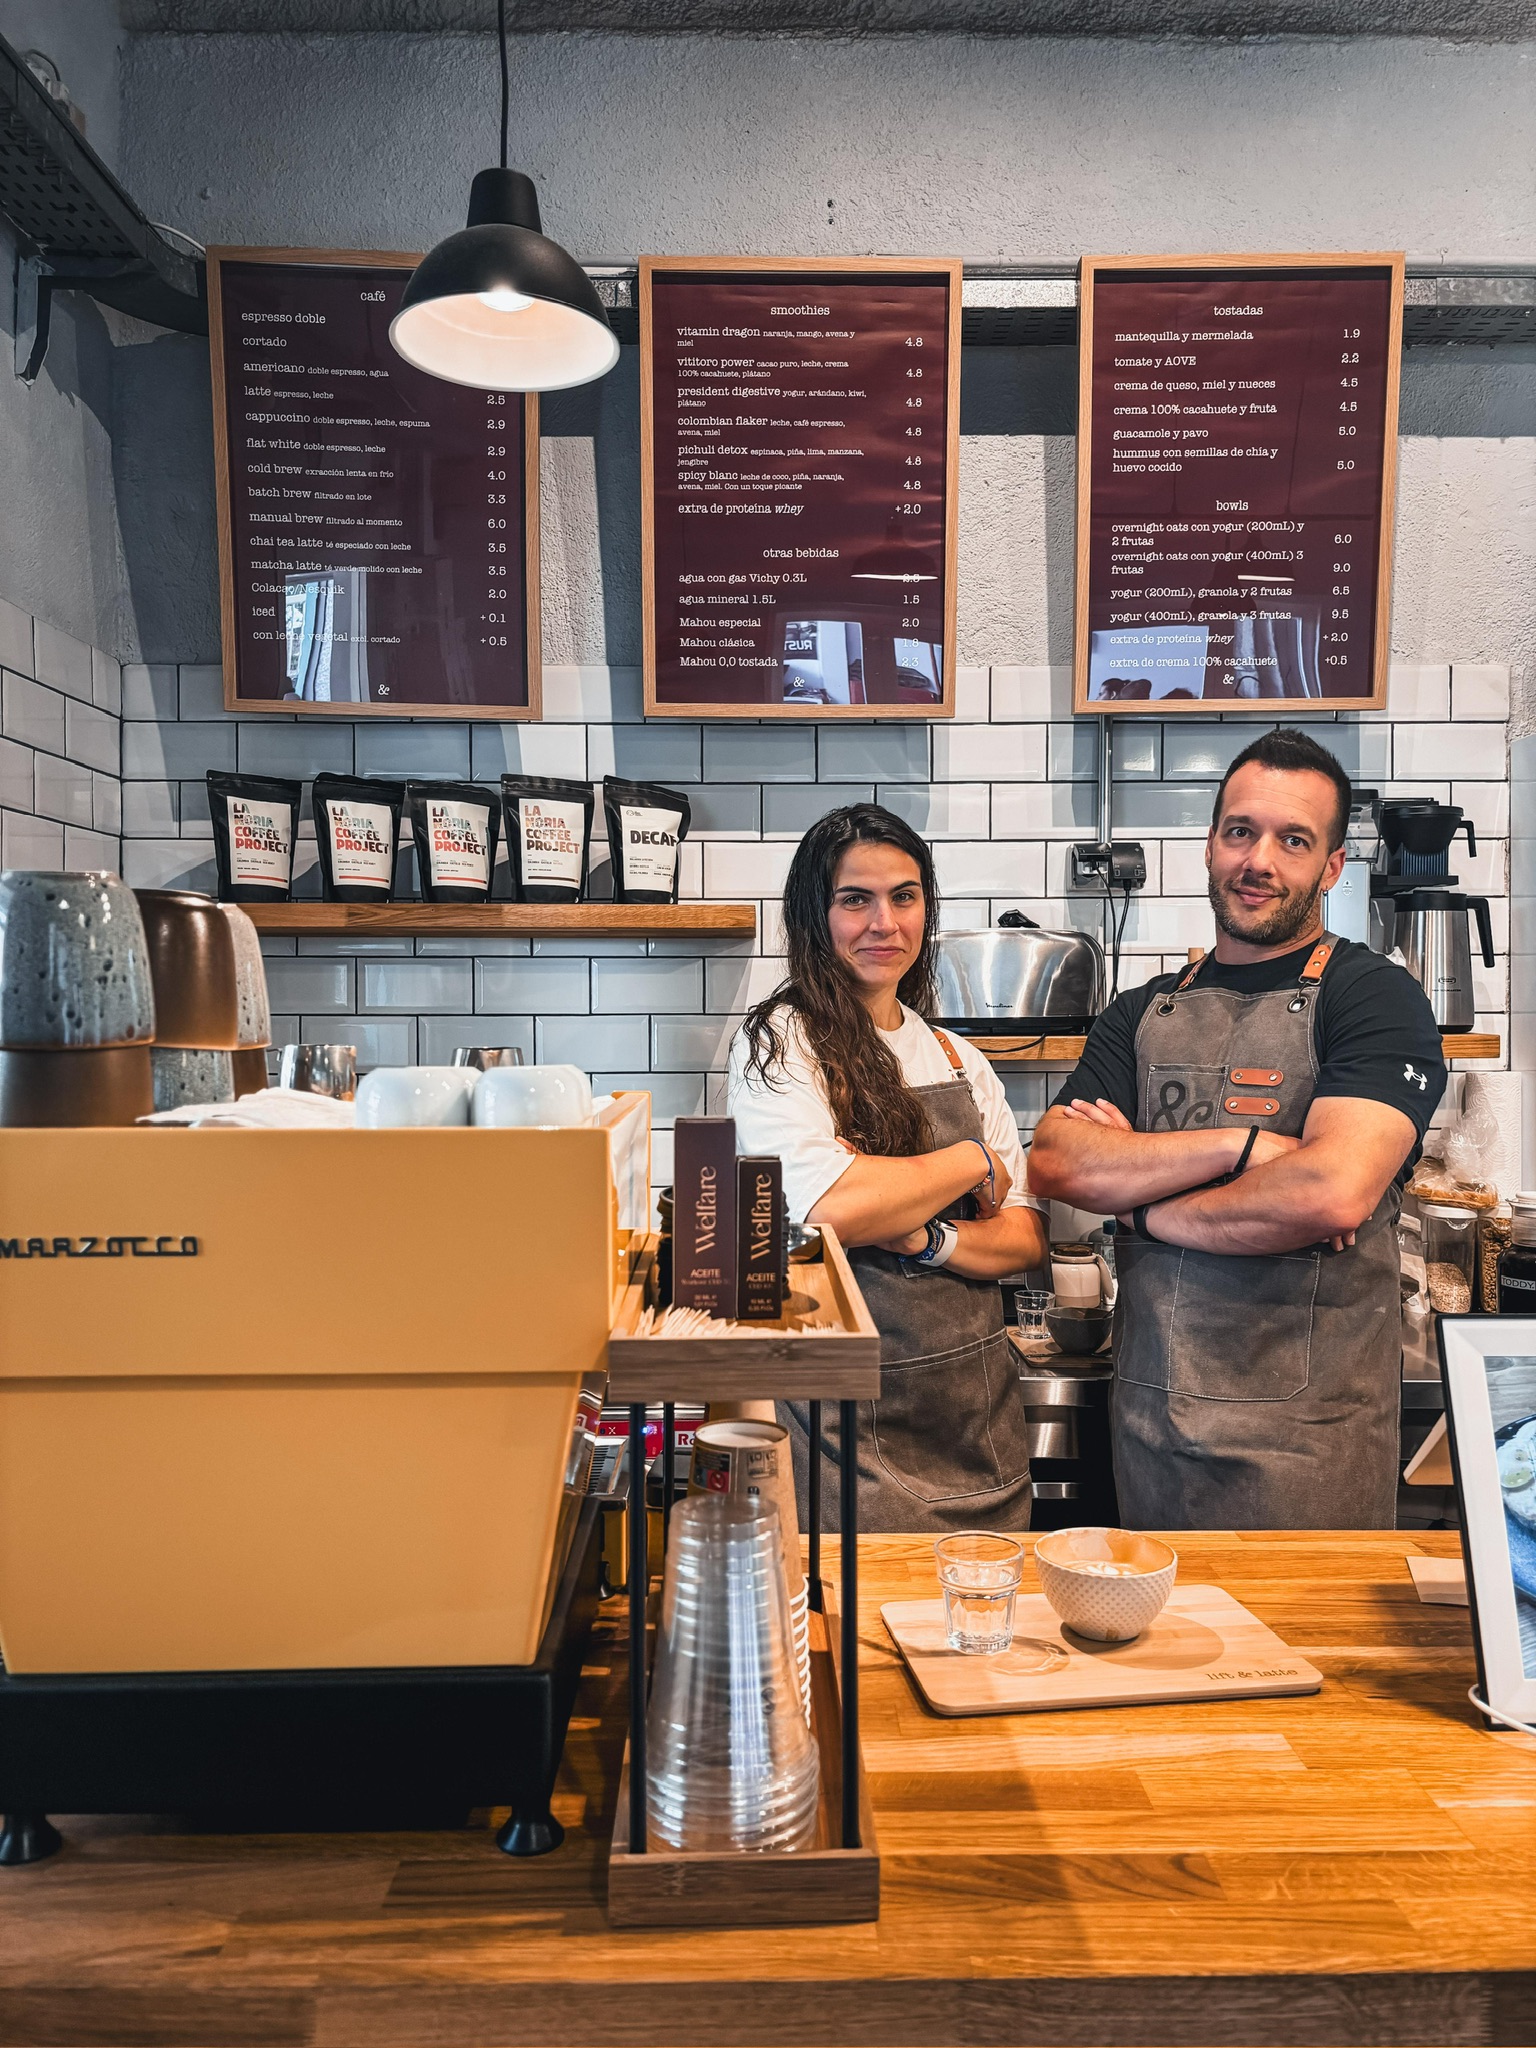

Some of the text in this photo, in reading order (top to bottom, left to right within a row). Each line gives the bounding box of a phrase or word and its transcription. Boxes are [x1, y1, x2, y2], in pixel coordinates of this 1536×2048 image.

[361, 290, 386, 301] café
[771, 304, 830, 315] smoothies
[1214, 304, 1263, 315] tostadas
[242, 312, 325, 324] espresso doble
[677, 326, 720, 336] vitamin
[722, 326, 760, 338] dragon
[763, 330, 795, 338] naranja,
[796, 330, 824, 338] mango,
[1115, 329, 1254, 343] mantequilla y mermelada
[1344, 328, 1360, 338] 1.9
[243, 335, 287, 347] cortado
[905, 337, 923, 346] 4.8
[677, 356, 754, 368] vititoro power
[1114, 355, 1196, 368] tomate y AOVE
[1341, 352, 1359, 363] 2.2
[244, 361, 389, 378] americano doble espresso, agua
[906, 368, 922, 377] 4.8
[1114, 379, 1275, 392] crema de queso, miel y nueces
[1341, 377, 1358, 387] 4.5
[245, 385, 334, 399] latte espresso, leche
[678, 386, 781, 397] president digestive
[487, 394, 505, 405] 2.5
[906, 397, 922, 407] 4.8
[1114, 402, 1277, 416] crema 100% cacahuete y fruta
[1340, 401, 1357, 411] 4.5
[246, 411, 430, 428] cappuccino doble espresso, leche, espuma
[487, 419, 505, 429] 2.9
[678, 415, 768, 425] colombian flaker
[905, 426, 922, 436] 4.8
[1113, 428, 1208, 440] guacamole y pavo
[1339, 425, 1356, 435] 5.0
[247, 437, 301, 449] flat white
[488, 445, 505, 456] 2.9
[678, 444, 748, 455] pichuli detox
[905, 455, 921, 465] 4.8
[1337, 459, 1354, 470] 5.0
[248, 462, 302, 474] cold brew
[1113, 461, 1182, 472] huevo cocido
[488, 470, 506, 480] 4.0
[678, 470, 738, 481] spicy blanc
[904, 480, 921, 489] 4.8
[248, 486, 311, 498] batch brew
[488, 493, 506, 504] 3.3
[679, 502, 804, 515] extra de proteína whey
[1216, 499, 1248, 511] bowls
[249, 511, 324, 524] manual brew
[488, 518, 506, 529] 6.0
[1112, 521, 1304, 534] overnight oats con yogur (200mL) y
[250, 535, 323, 547] chai tea latte
[1335, 533, 1352, 543] 6.0
[488, 542, 506, 553] 3.5
[763, 547, 839, 557] otras bebidas
[251, 559, 322, 571] matcha latte
[679, 573, 705, 584] agua
[729, 574, 746, 584] gas
[749, 573, 780, 584] Vichy
[783, 573, 807, 582] 0.3L
[679, 594, 776, 605] agua mineral 1.5L
[253, 606, 275, 616] iced
[680, 617, 761, 628] Mahou especial
[680, 637, 755, 647] Mahou clásica
[680, 656, 778, 667] Mahou 0,0 tostada
[233, 802, 250, 813] LA
[332, 806, 349, 817] LA
[432, 805, 449, 817] LA
[524, 805, 541, 816] LA
[234, 826, 281, 841] COFFEE
[335, 827, 380, 841] COFFEE
[433, 829, 478, 843] COFFEE
[526, 828, 571, 841] COFFEE
[235, 838, 289, 854] PROJECT
[336, 839, 389, 855] PROJECT
[435, 841, 487, 856] PROJECT
[526, 840, 580, 855] PROJECT
[695, 1165, 717, 1255] Welfare
[751, 1173, 773, 1261] Welfare
[690, 1268, 721, 1279] ACEITE
[746, 1272, 776, 1283] ACEITE
[1238, 1671, 1253, 1679] &
[1255, 1669, 1298, 1678] latte
